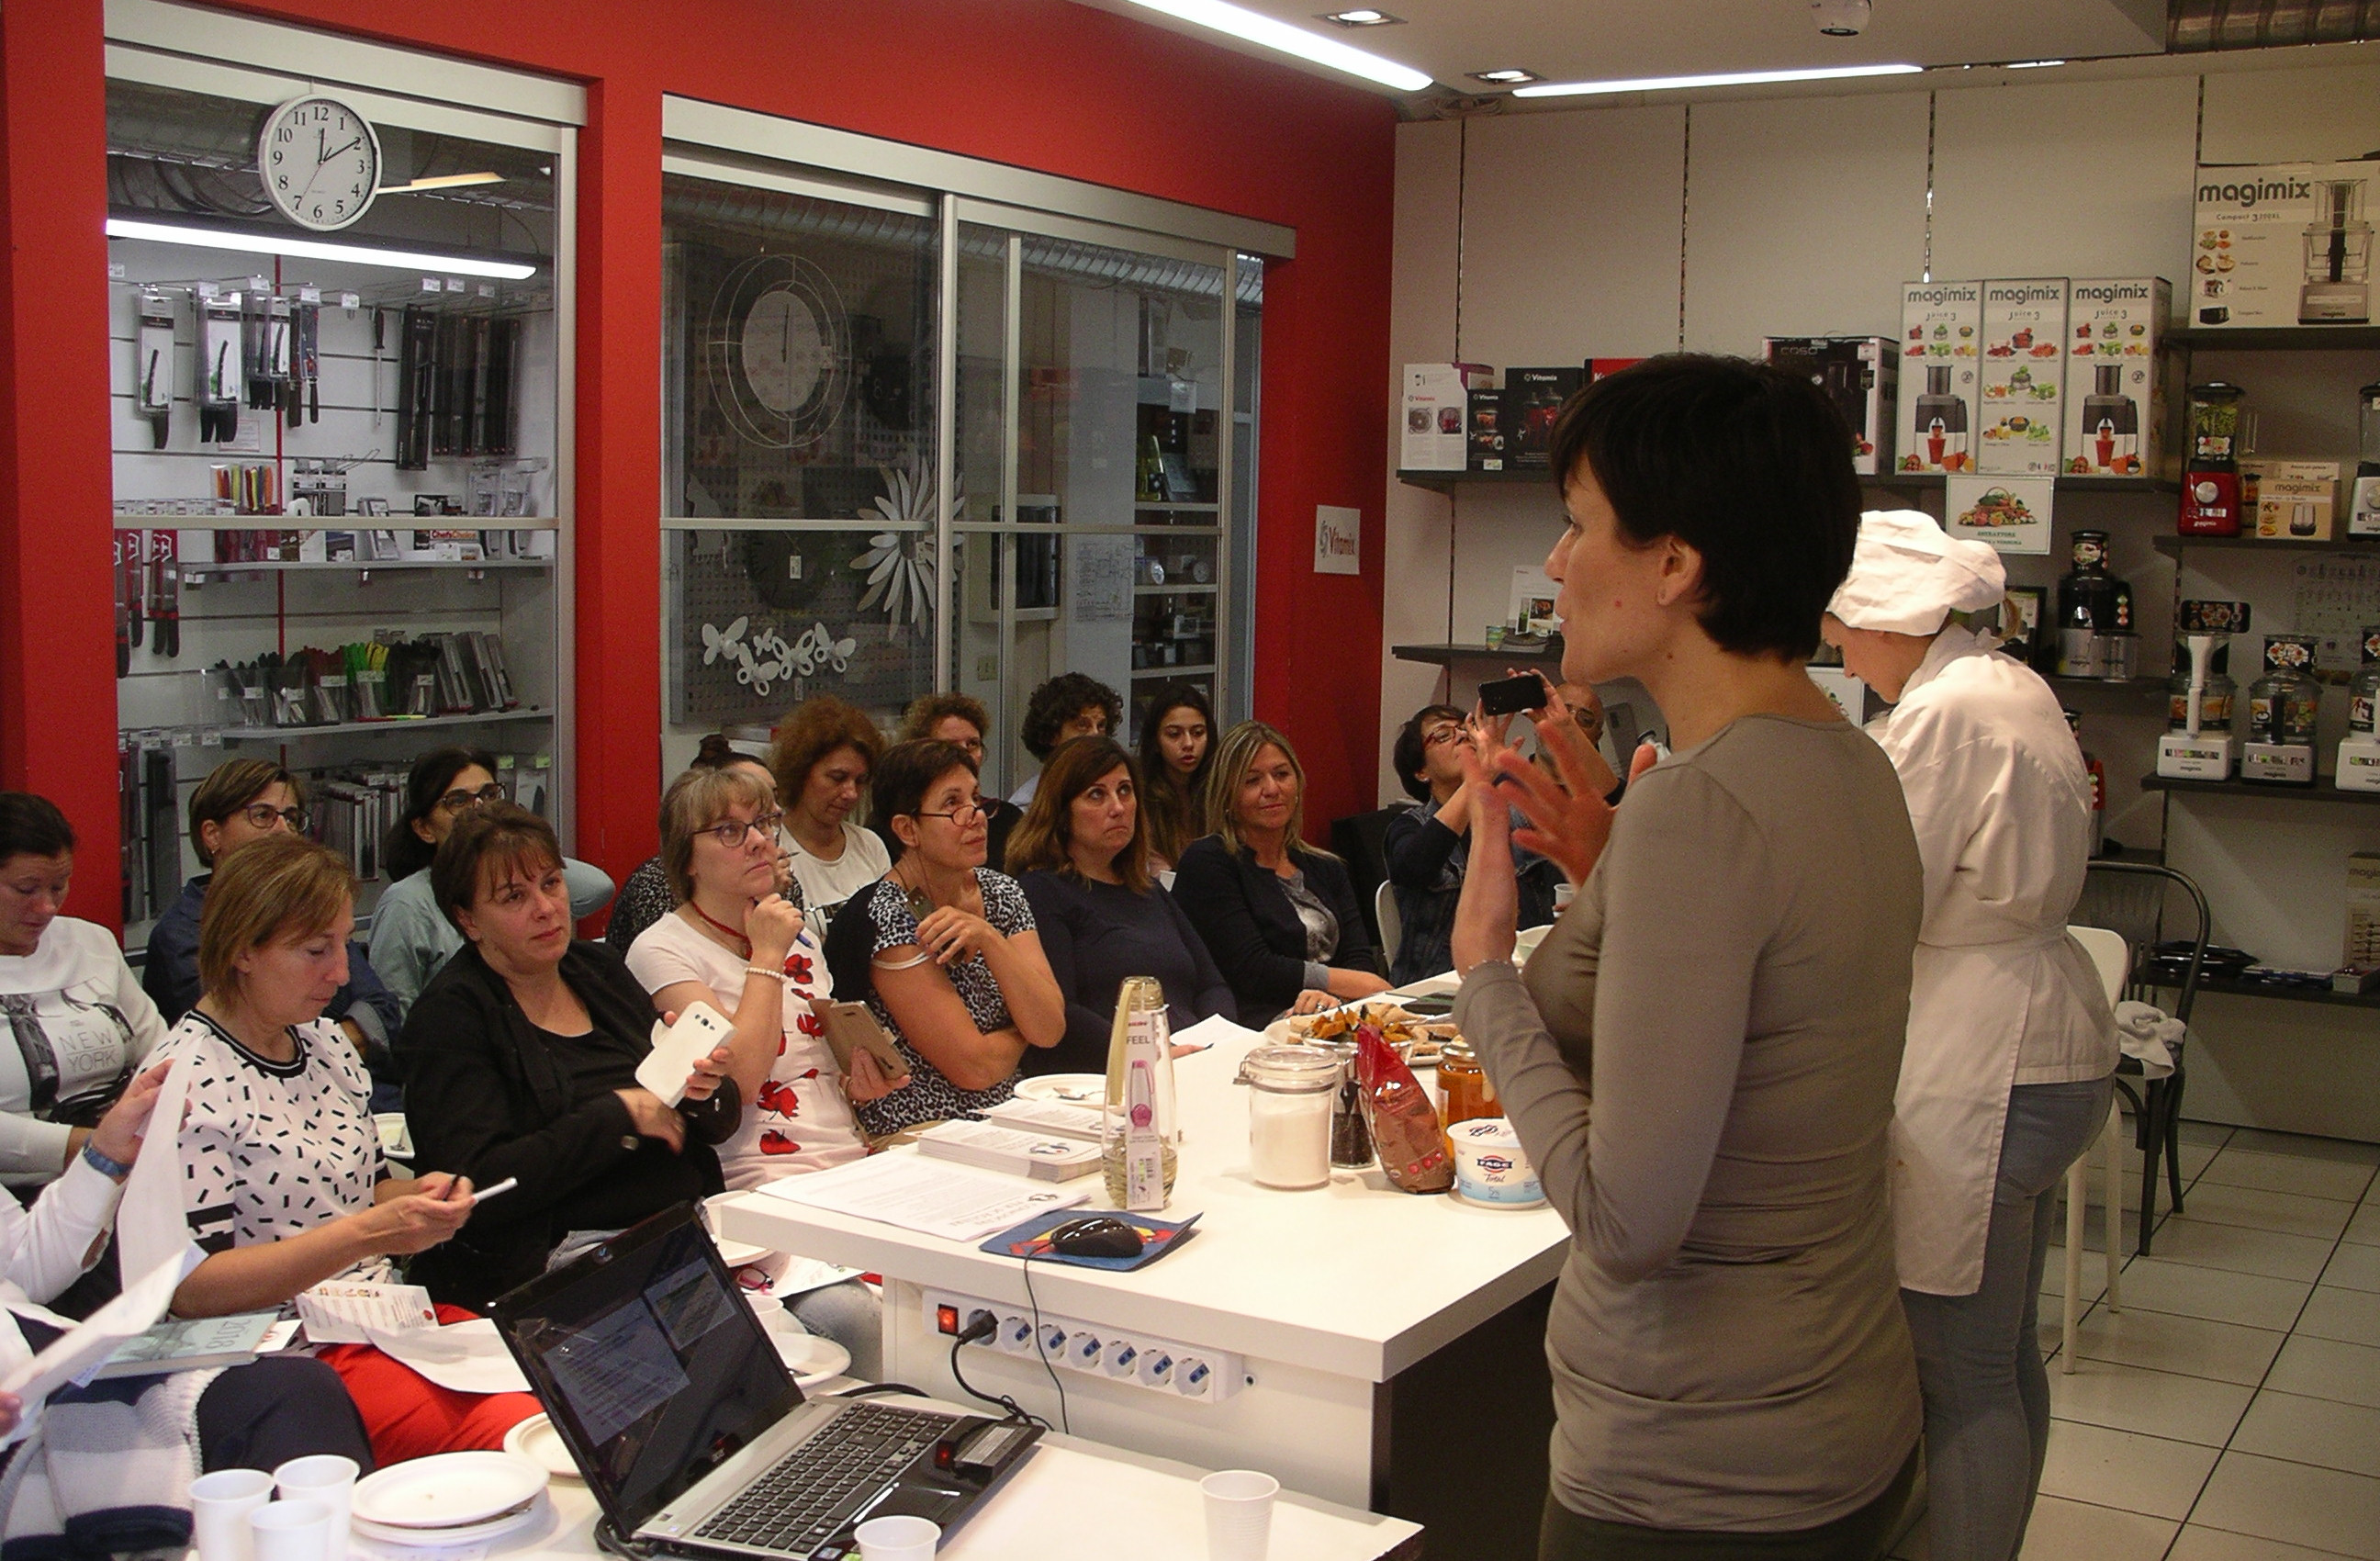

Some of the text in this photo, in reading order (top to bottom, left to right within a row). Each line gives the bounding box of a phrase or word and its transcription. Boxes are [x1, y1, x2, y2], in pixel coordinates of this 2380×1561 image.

[294, 111, 306, 126] 11
[314, 107, 329, 121] 12
[339, 117, 344, 130] 1
[278, 128, 292, 142] 10
[274, 151, 283, 165] 9
[356, 160, 365, 174] 3
[278, 175, 288, 190] 8
[351, 183, 360, 197] 4
[2198, 176, 2311, 208] magimix
[294, 196, 302, 210] 7
[335, 200, 343, 214] 5
[313, 205, 322, 219] 6
[1907, 286, 1977, 306] magimix
[1989, 285, 2060, 305] magimix
[2075, 283, 2149, 304] magimix
[2274, 482, 2321, 495] magimix
[59, 1029, 112, 1052] NEW
[1126, 1035, 1151, 1045] FEEL
[67, 1050, 118, 1072] YORK
[206, 1318, 252, 1350] 2018
